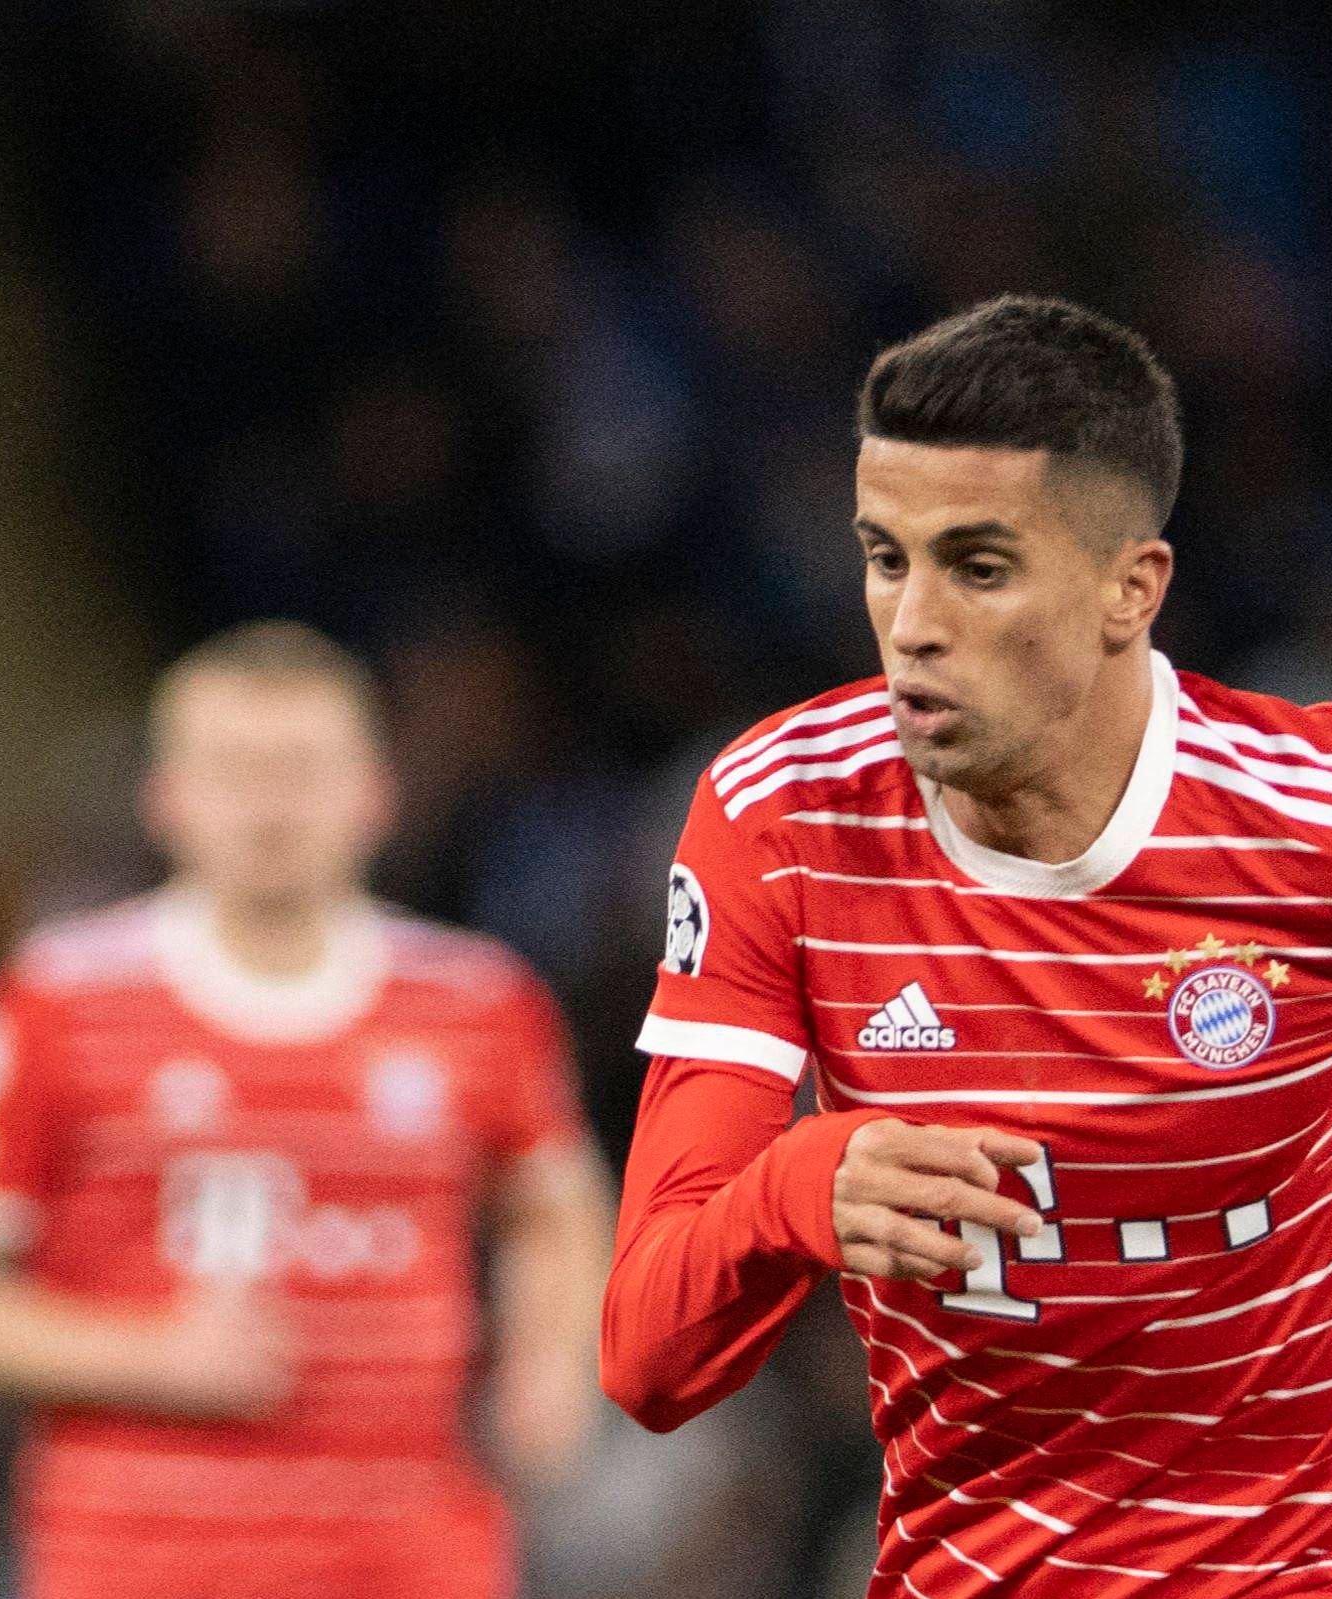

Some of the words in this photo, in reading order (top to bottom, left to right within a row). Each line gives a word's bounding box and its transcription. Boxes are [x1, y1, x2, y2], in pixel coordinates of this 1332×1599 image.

[1176, 990, 1196, 1016] FC
[1192, 973, 1263, 1009] BAYERN
[857, 1024, 957, 1050] adidas
